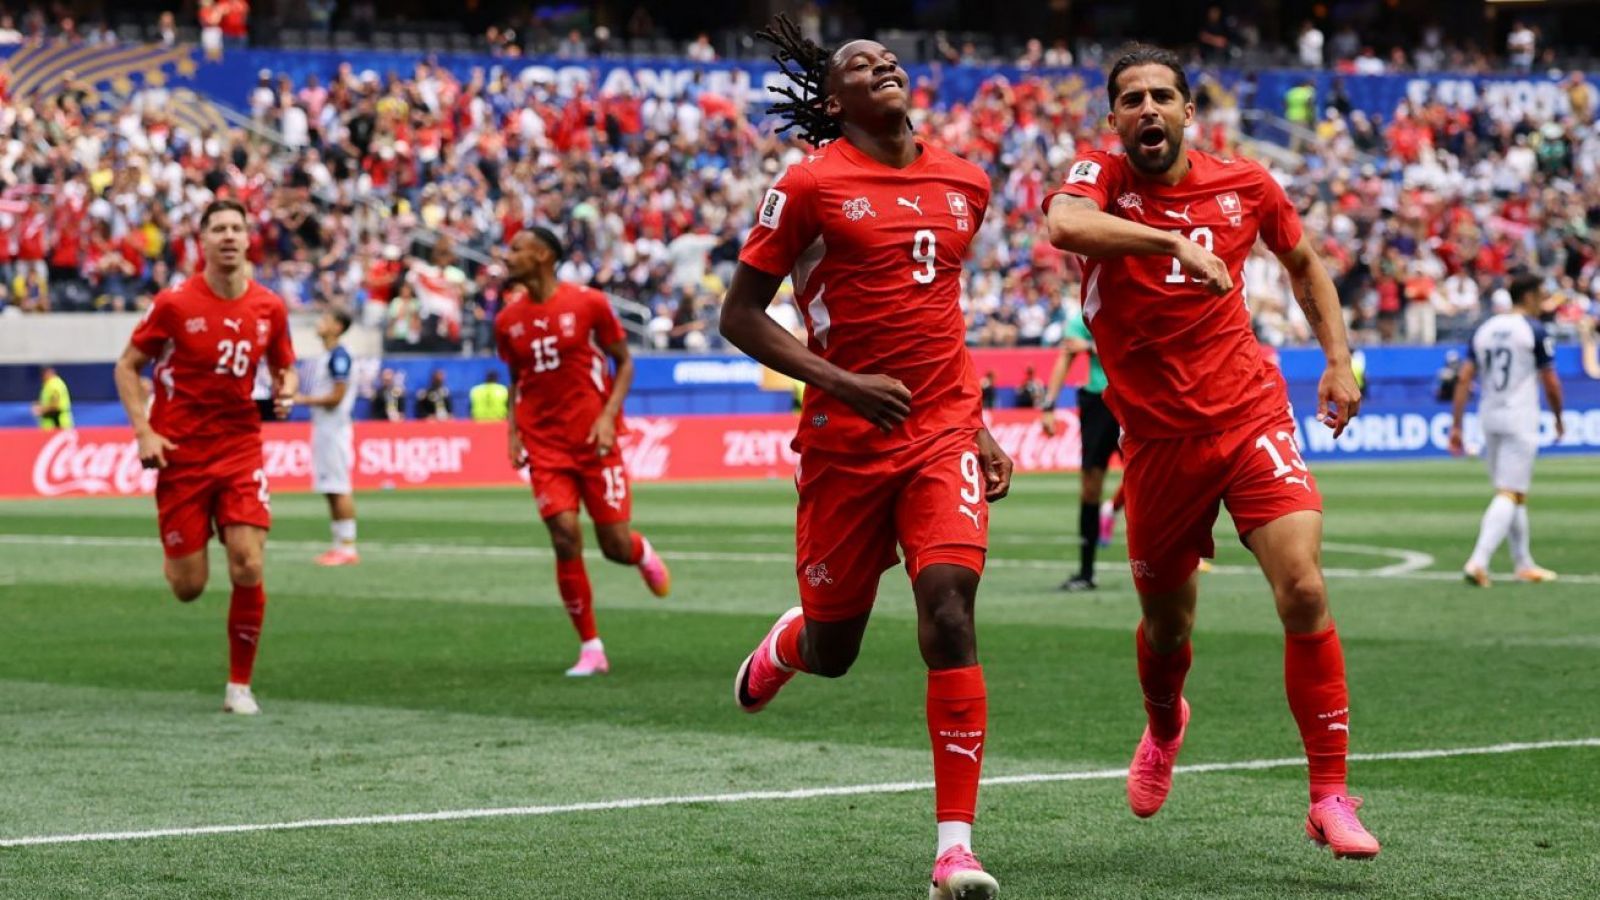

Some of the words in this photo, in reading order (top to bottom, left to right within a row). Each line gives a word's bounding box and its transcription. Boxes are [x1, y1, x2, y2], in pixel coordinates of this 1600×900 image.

[912, 228, 936, 284] 9
[215, 338, 252, 377] 26
[530, 335, 560, 373] 15
[1484, 346, 1513, 392] 13
[1304, 412, 1428, 452] WORLD
[358, 437, 472, 483] sugar
[1255, 431, 1308, 478] 13
[601, 465, 626, 500] 15
[960, 450, 980, 505] 9
[939, 729, 983, 738] suisse
